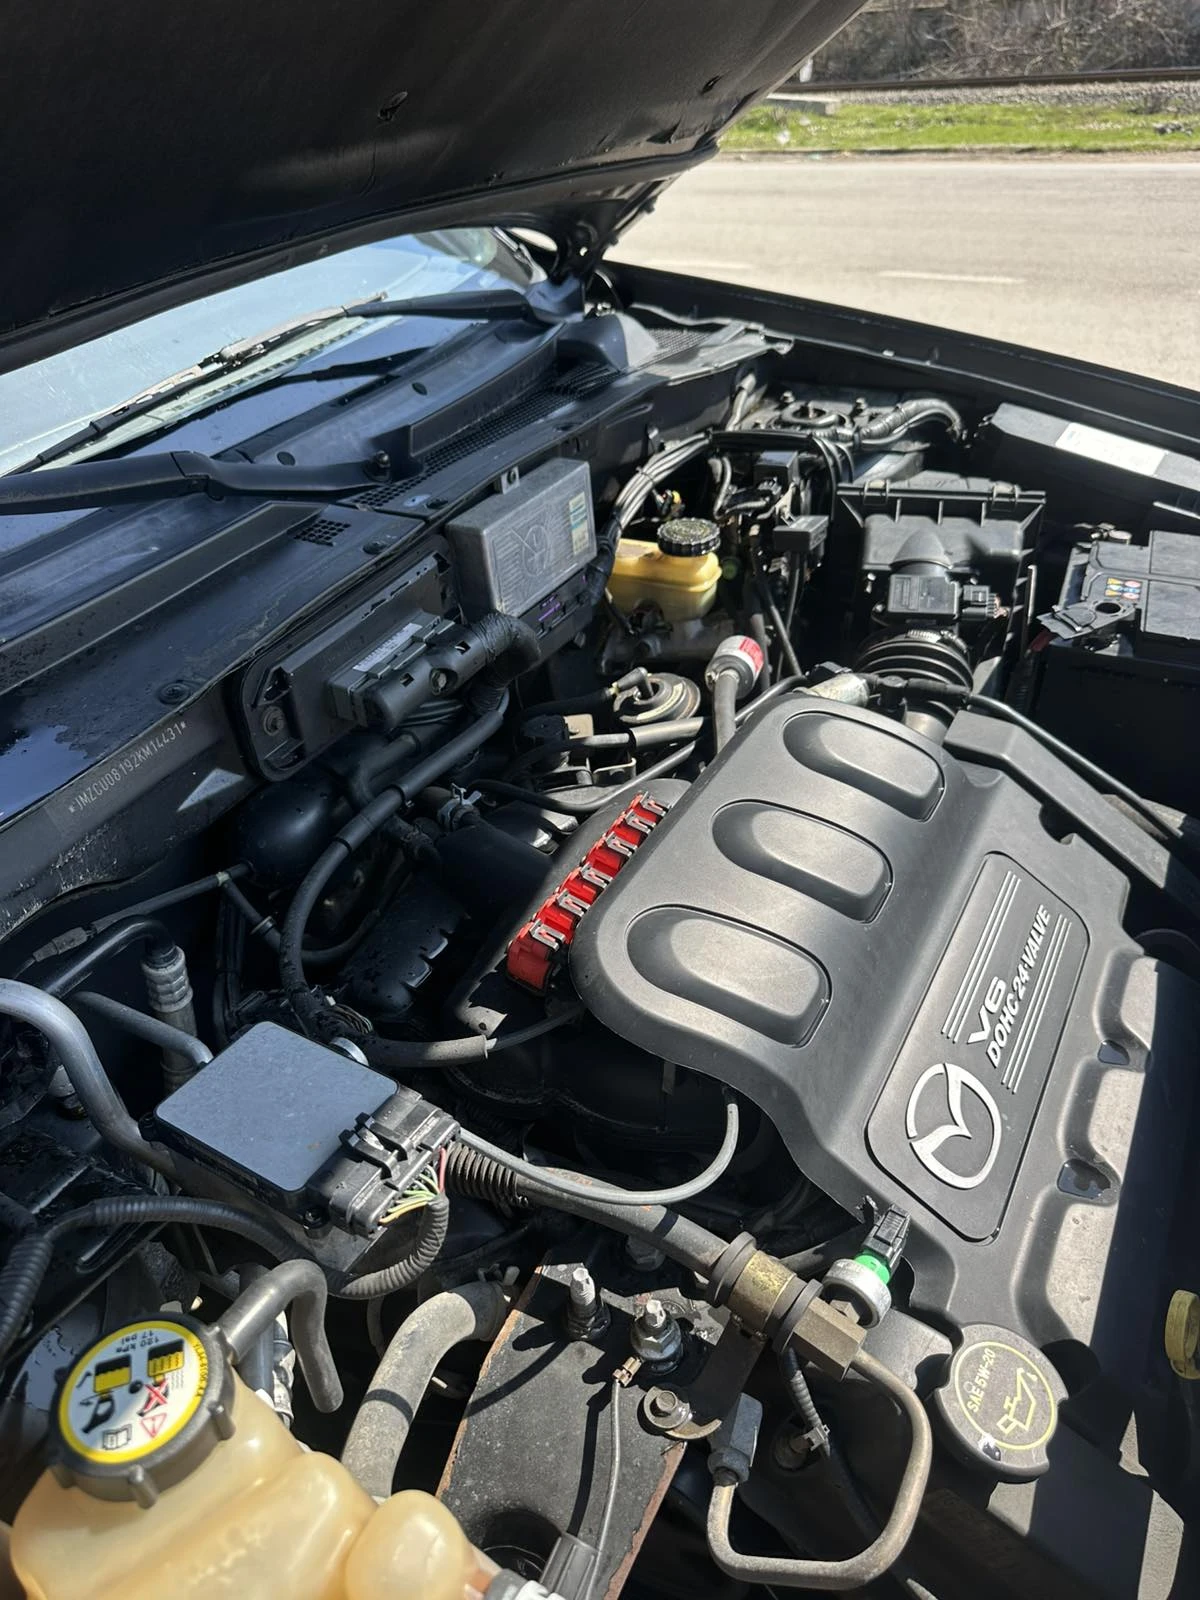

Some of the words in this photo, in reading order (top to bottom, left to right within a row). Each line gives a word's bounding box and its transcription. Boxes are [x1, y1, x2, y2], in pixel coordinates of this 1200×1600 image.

[967, 976, 1006, 1044] V6
[986, 993, 1019, 1068] DOHC
[121, 1335, 137, 1345] psi
[140, 1337, 160, 1347] 120
[142, 1330, 154, 1338] 17
[116, 1344, 136, 1353] kPa
[975, 1348, 996, 1388] 5W-20
[967, 1386, 984, 1413] SAE
